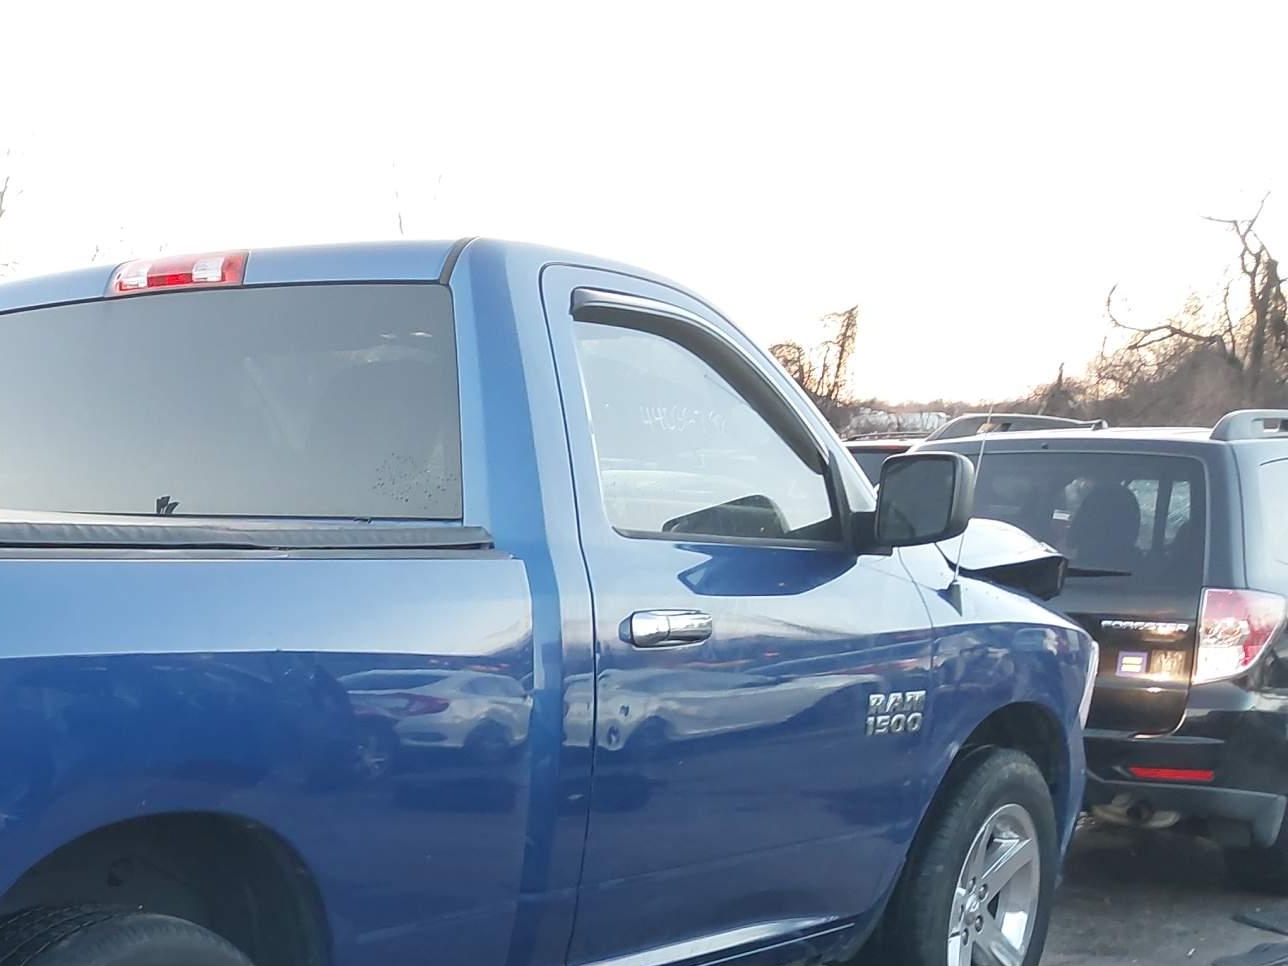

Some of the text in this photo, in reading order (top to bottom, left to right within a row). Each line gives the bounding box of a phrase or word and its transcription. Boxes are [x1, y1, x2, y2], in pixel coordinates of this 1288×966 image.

[1101, 620, 1189, 634] FORESTER
[867, 690, 926, 714] RAM
[865, 712, 922, 736] 1500
